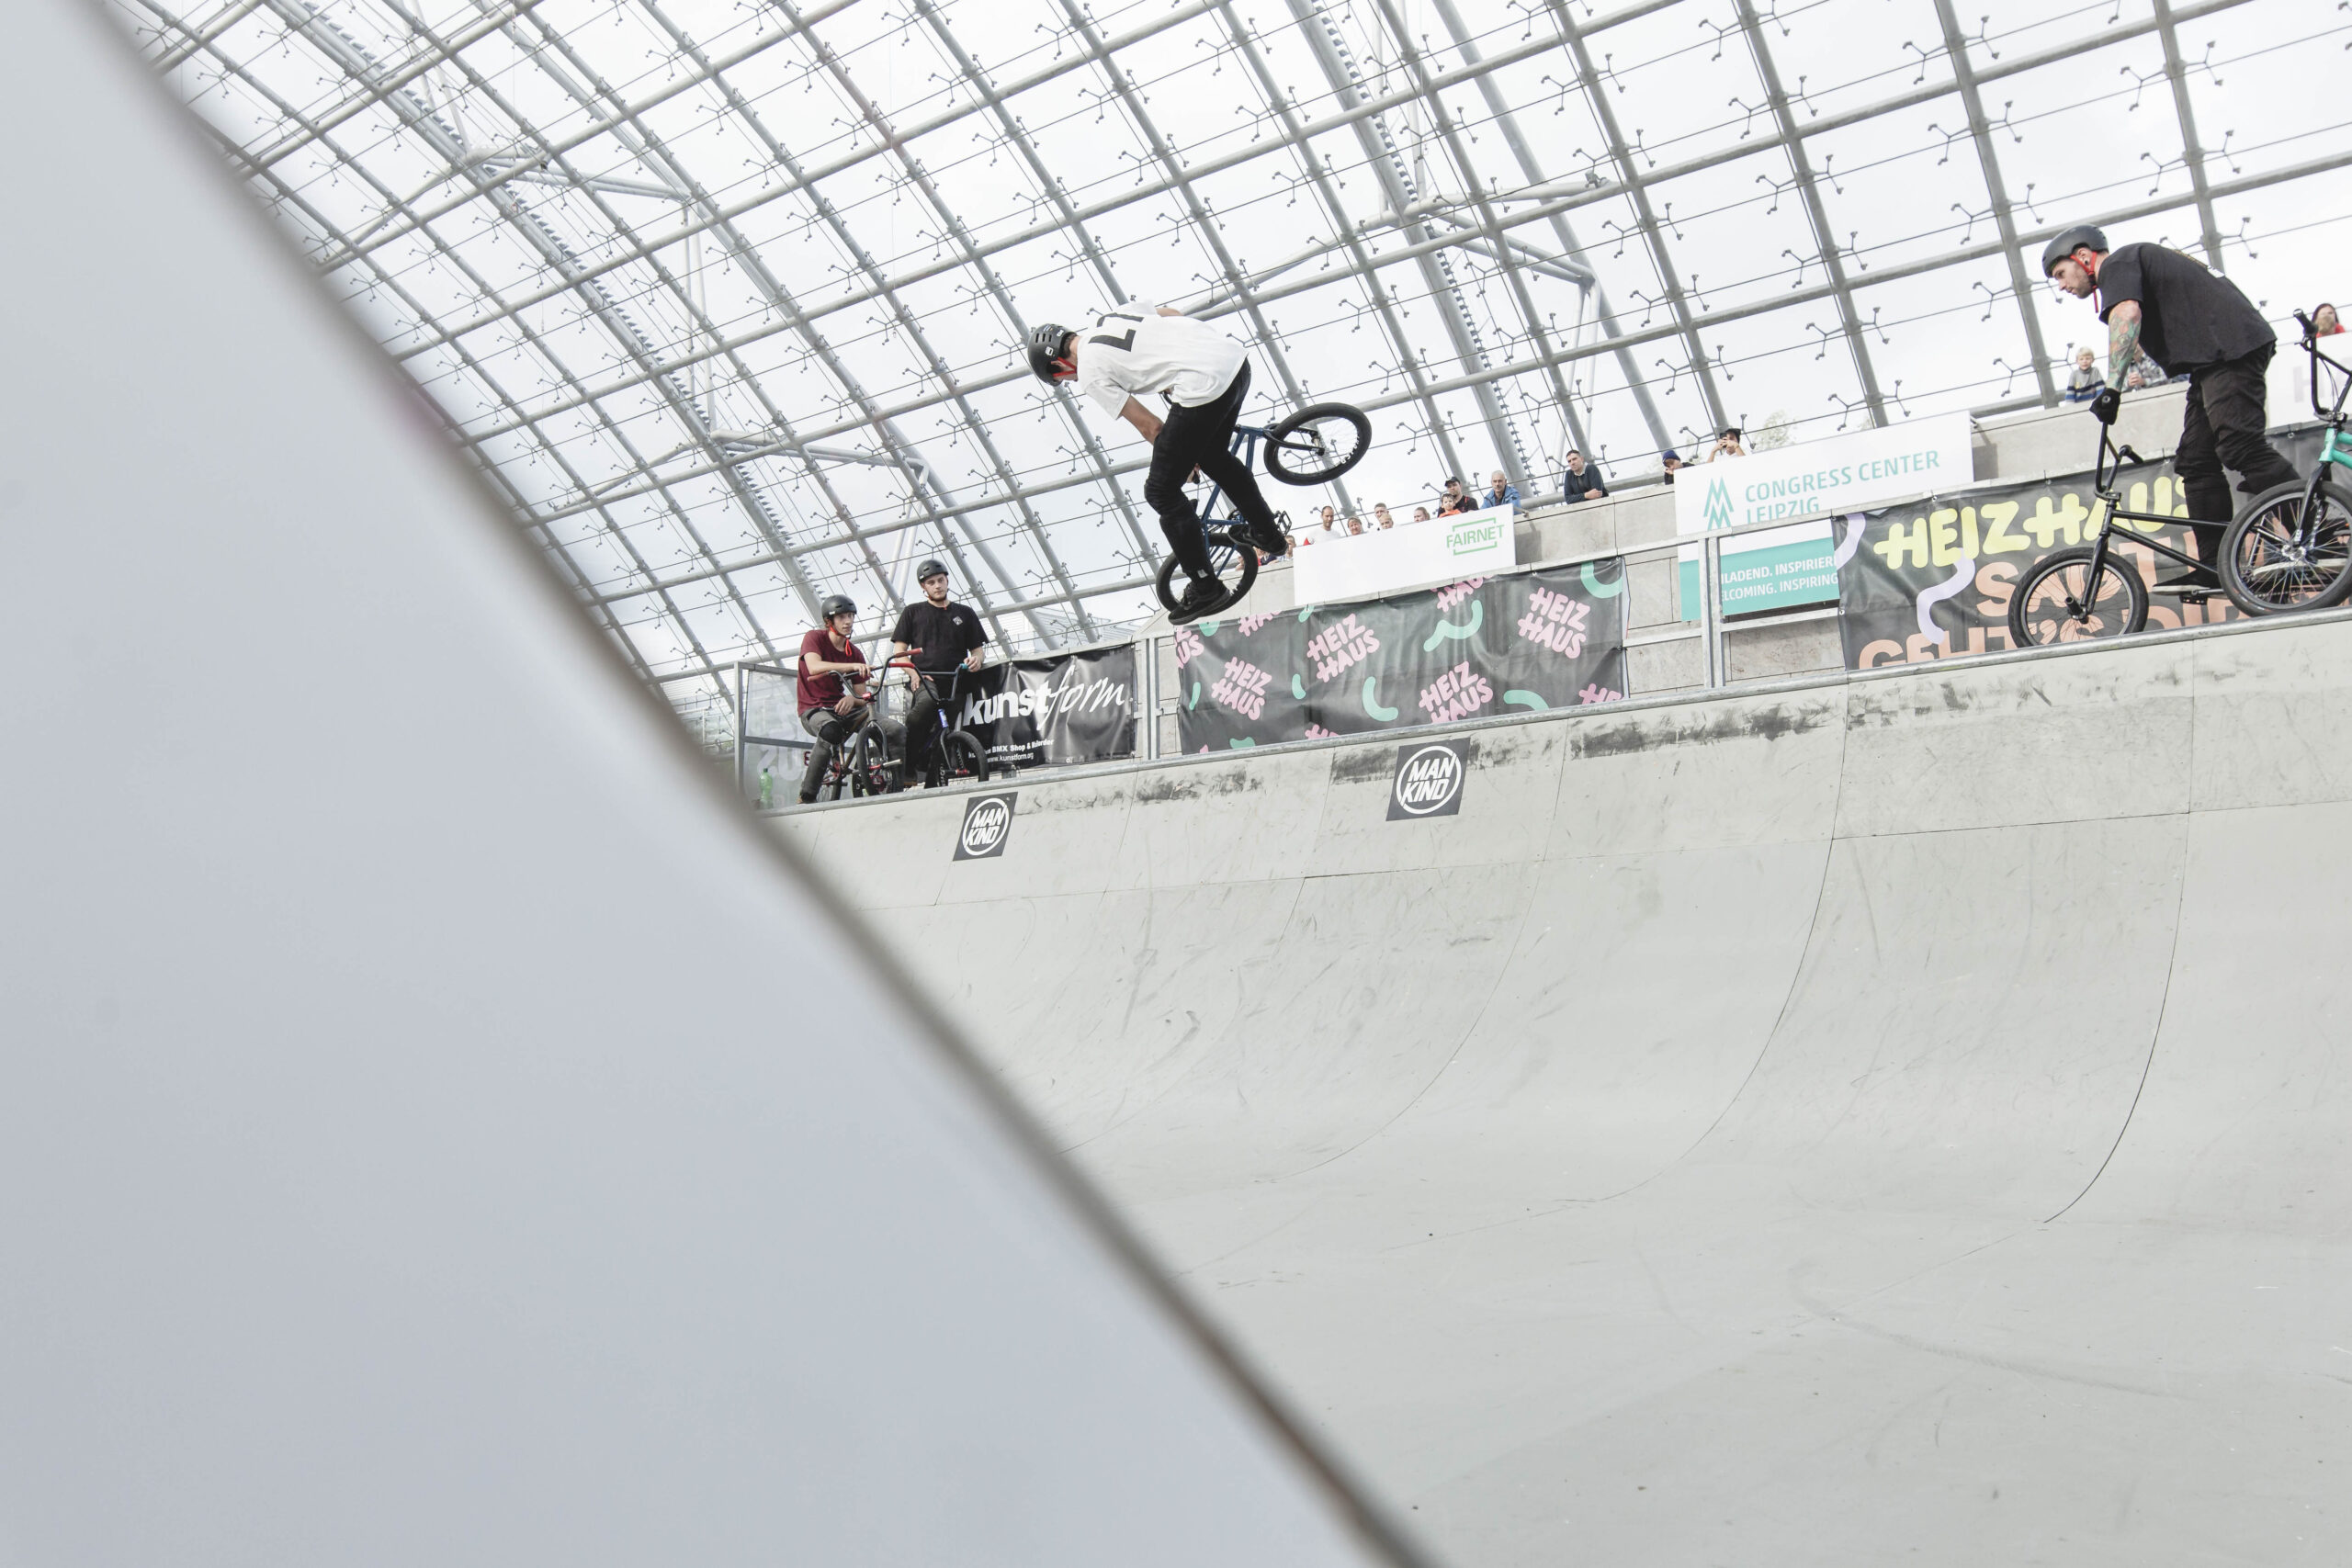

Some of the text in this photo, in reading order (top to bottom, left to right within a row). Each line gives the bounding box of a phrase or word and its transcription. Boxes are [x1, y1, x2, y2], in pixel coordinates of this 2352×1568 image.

[1745, 450, 1940, 503] CONGRESS CENTER
[1747, 496, 1820, 524] LEIPZIG
[1446, 524, 1505, 548] FAIRNET
[1437, 576, 1493, 613] HAU
[1529, 587, 1590, 632] HEIZ
[1306, 614, 1366, 661] HEIZ
[1518, 612, 1587, 659] HAUS
[1317, 629, 1380, 682] HAUS
[1224, 657, 1272, 696] HEIZ
[1419, 661, 1479, 712] HEIZ
[1211, 678, 1265, 720] HAUS
[992, 745, 1009, 753] BMX
[1011, 743, 1025, 752] Shop
[1407, 753, 1456, 783] MAN
[1400, 778, 1450, 805] KIND
[965, 825, 1001, 847] KIND
[971, 805, 1007, 829] MAN
